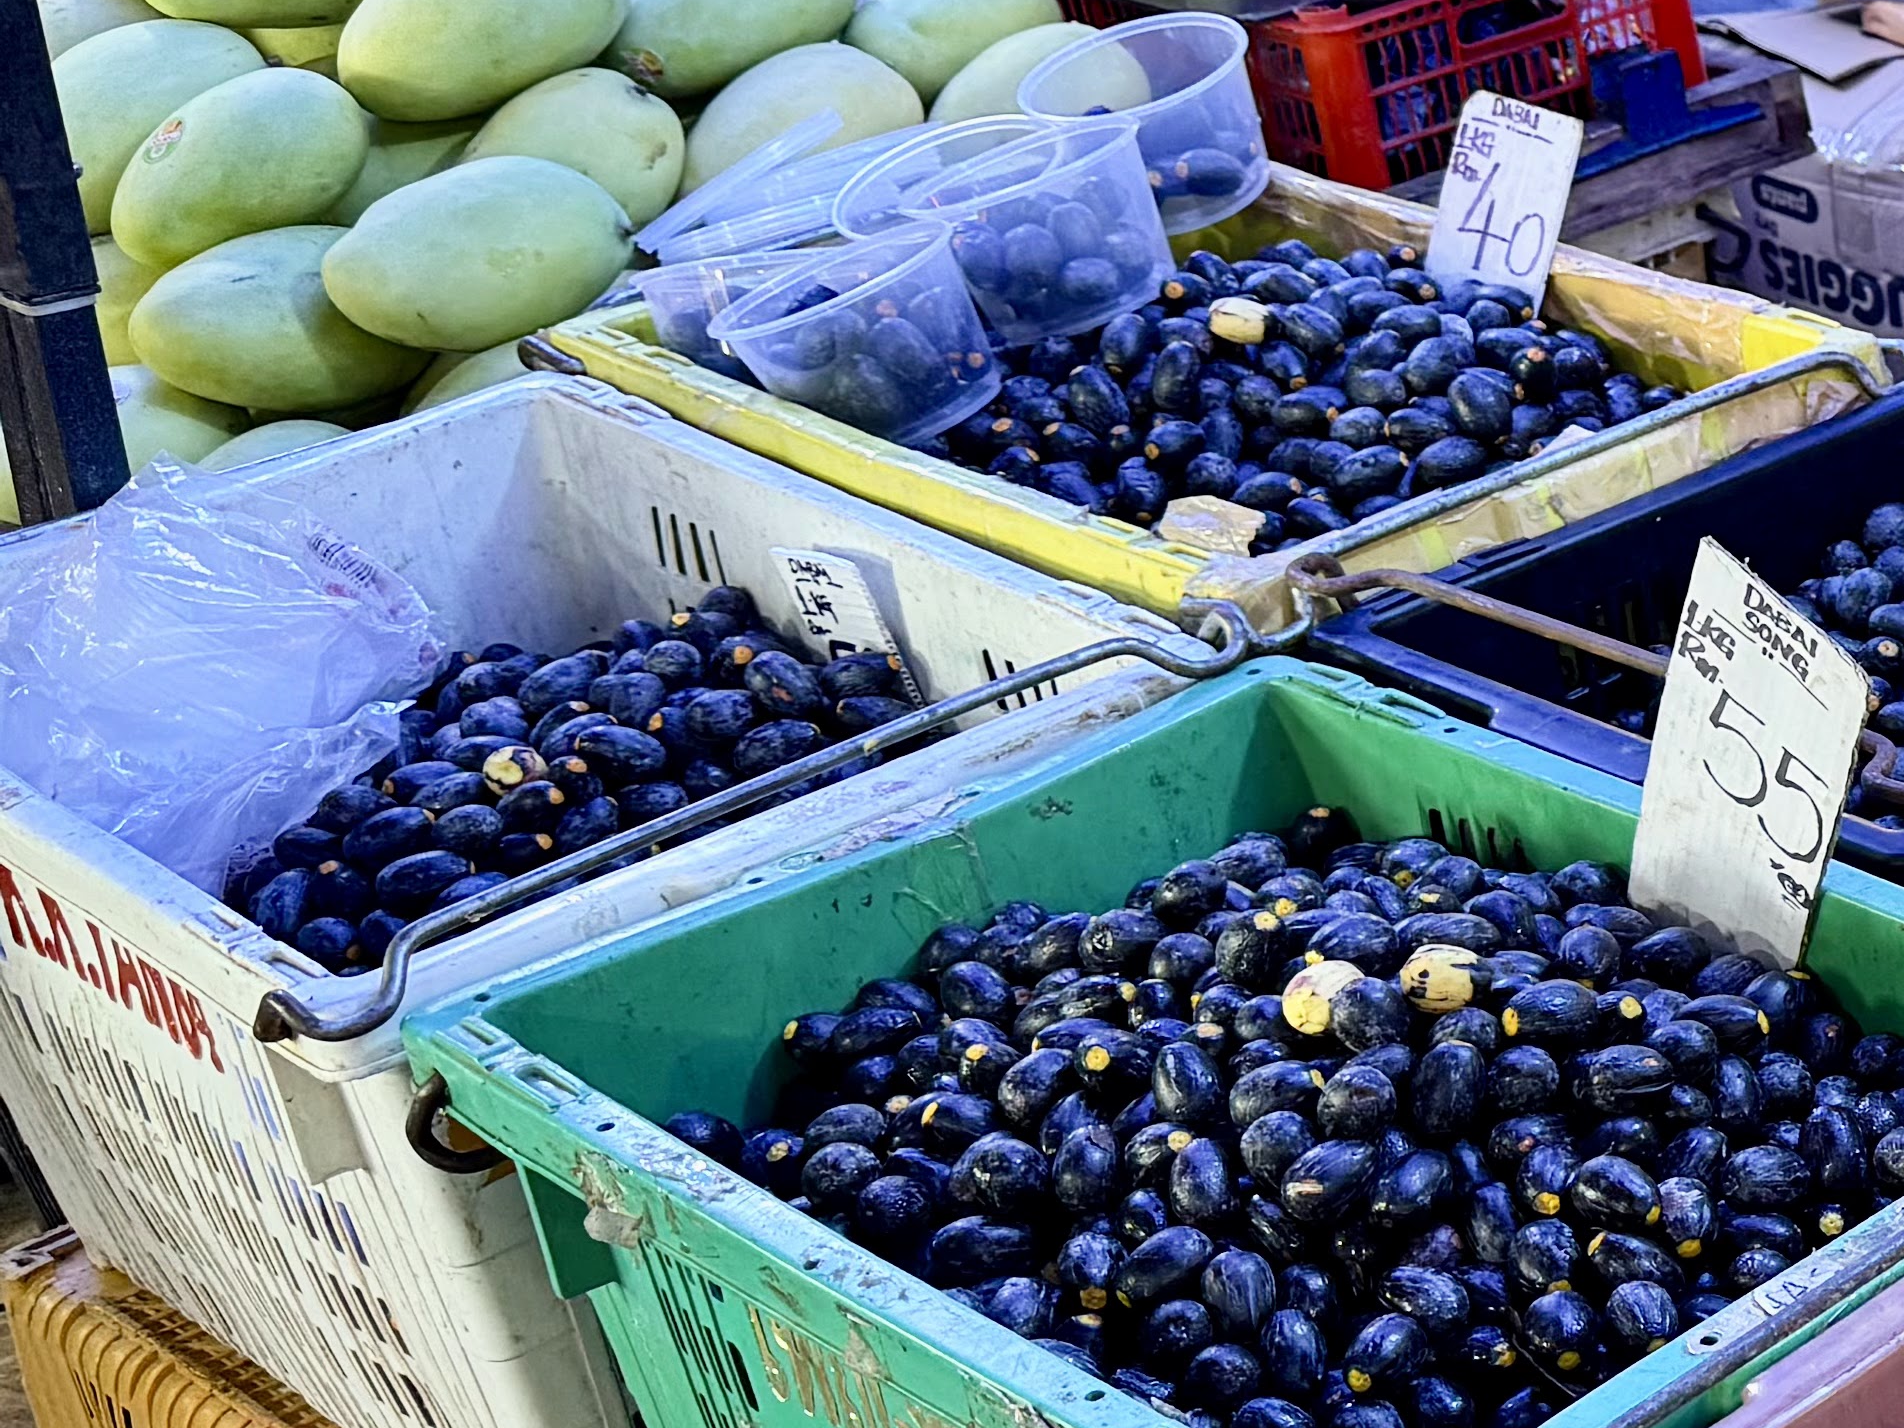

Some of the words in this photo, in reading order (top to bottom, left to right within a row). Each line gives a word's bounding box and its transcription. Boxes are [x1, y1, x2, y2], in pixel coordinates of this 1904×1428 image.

[1457, 162, 1545, 277] 40
[1742, 611, 1810, 682] SONG
[1744, 582, 1819, 658] DABAI
[1702, 688, 1830, 864] 55
